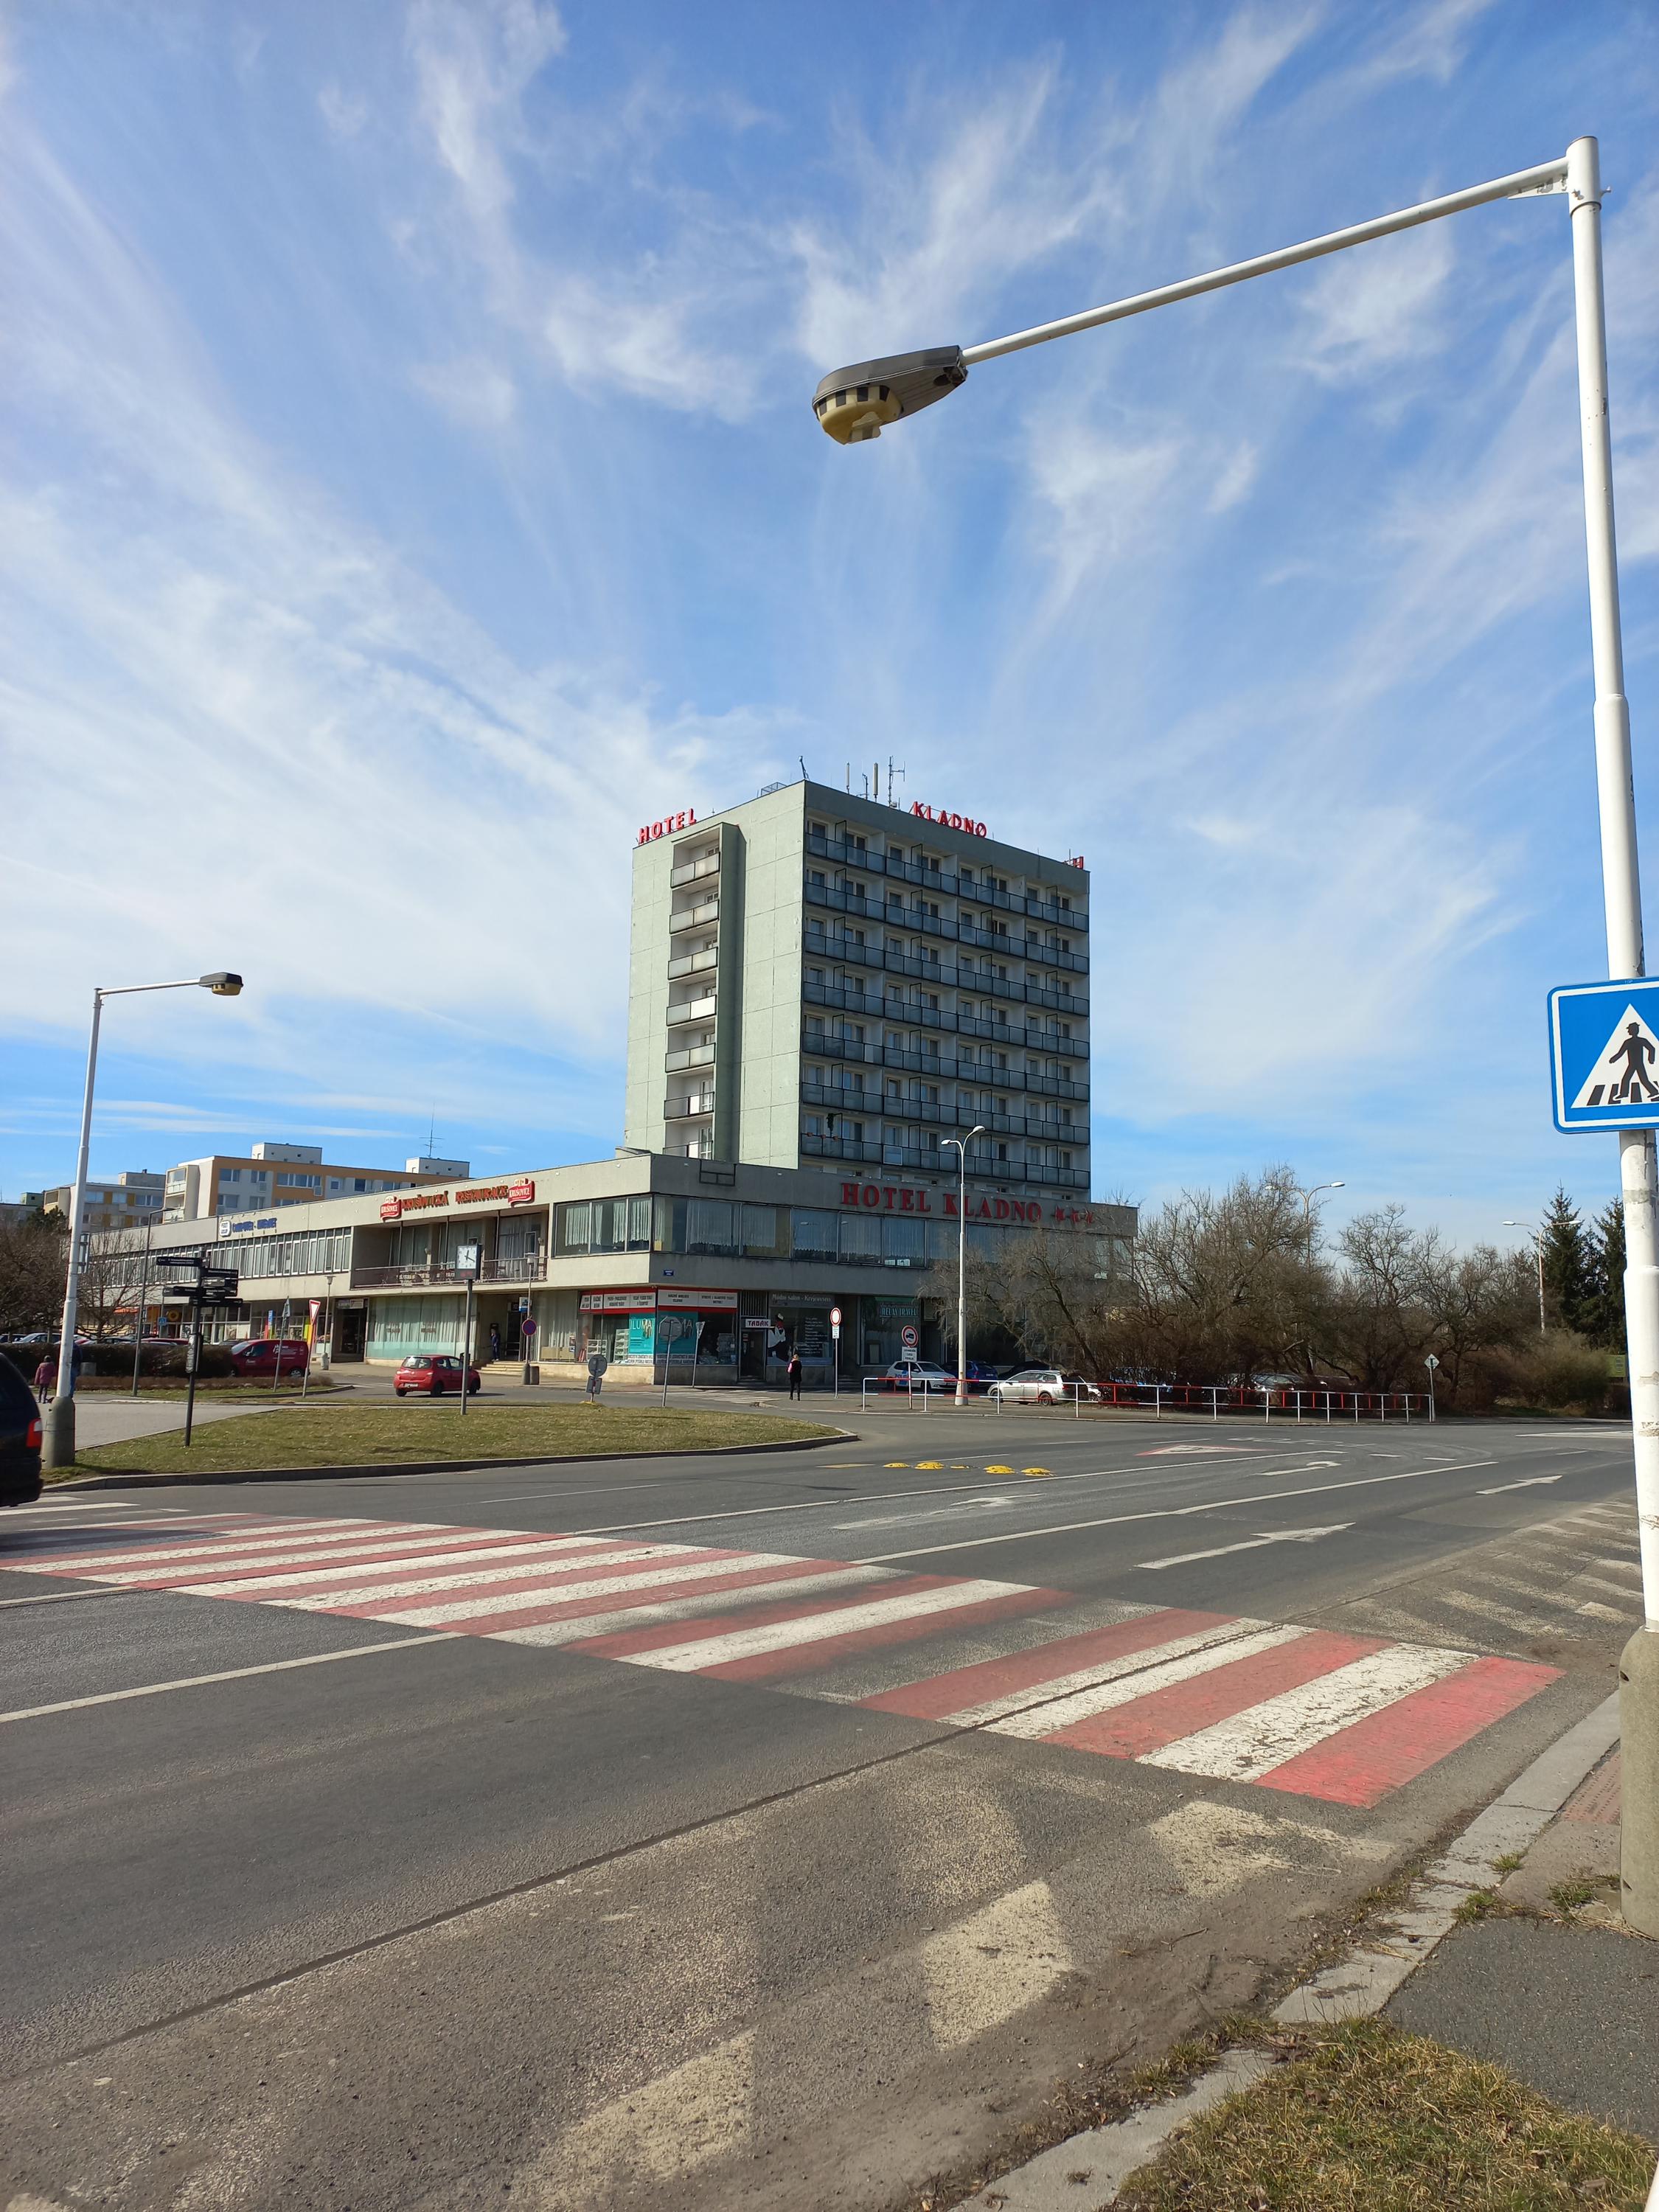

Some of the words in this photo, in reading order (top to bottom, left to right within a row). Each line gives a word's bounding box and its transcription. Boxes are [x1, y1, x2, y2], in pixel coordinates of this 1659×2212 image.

[638, 808, 697, 845] HOTEL
[914, 801, 987, 838] KLADNO
[841, 1182, 931, 1213] HOTEL
[943, 1193, 1042, 1223] KLADNO
